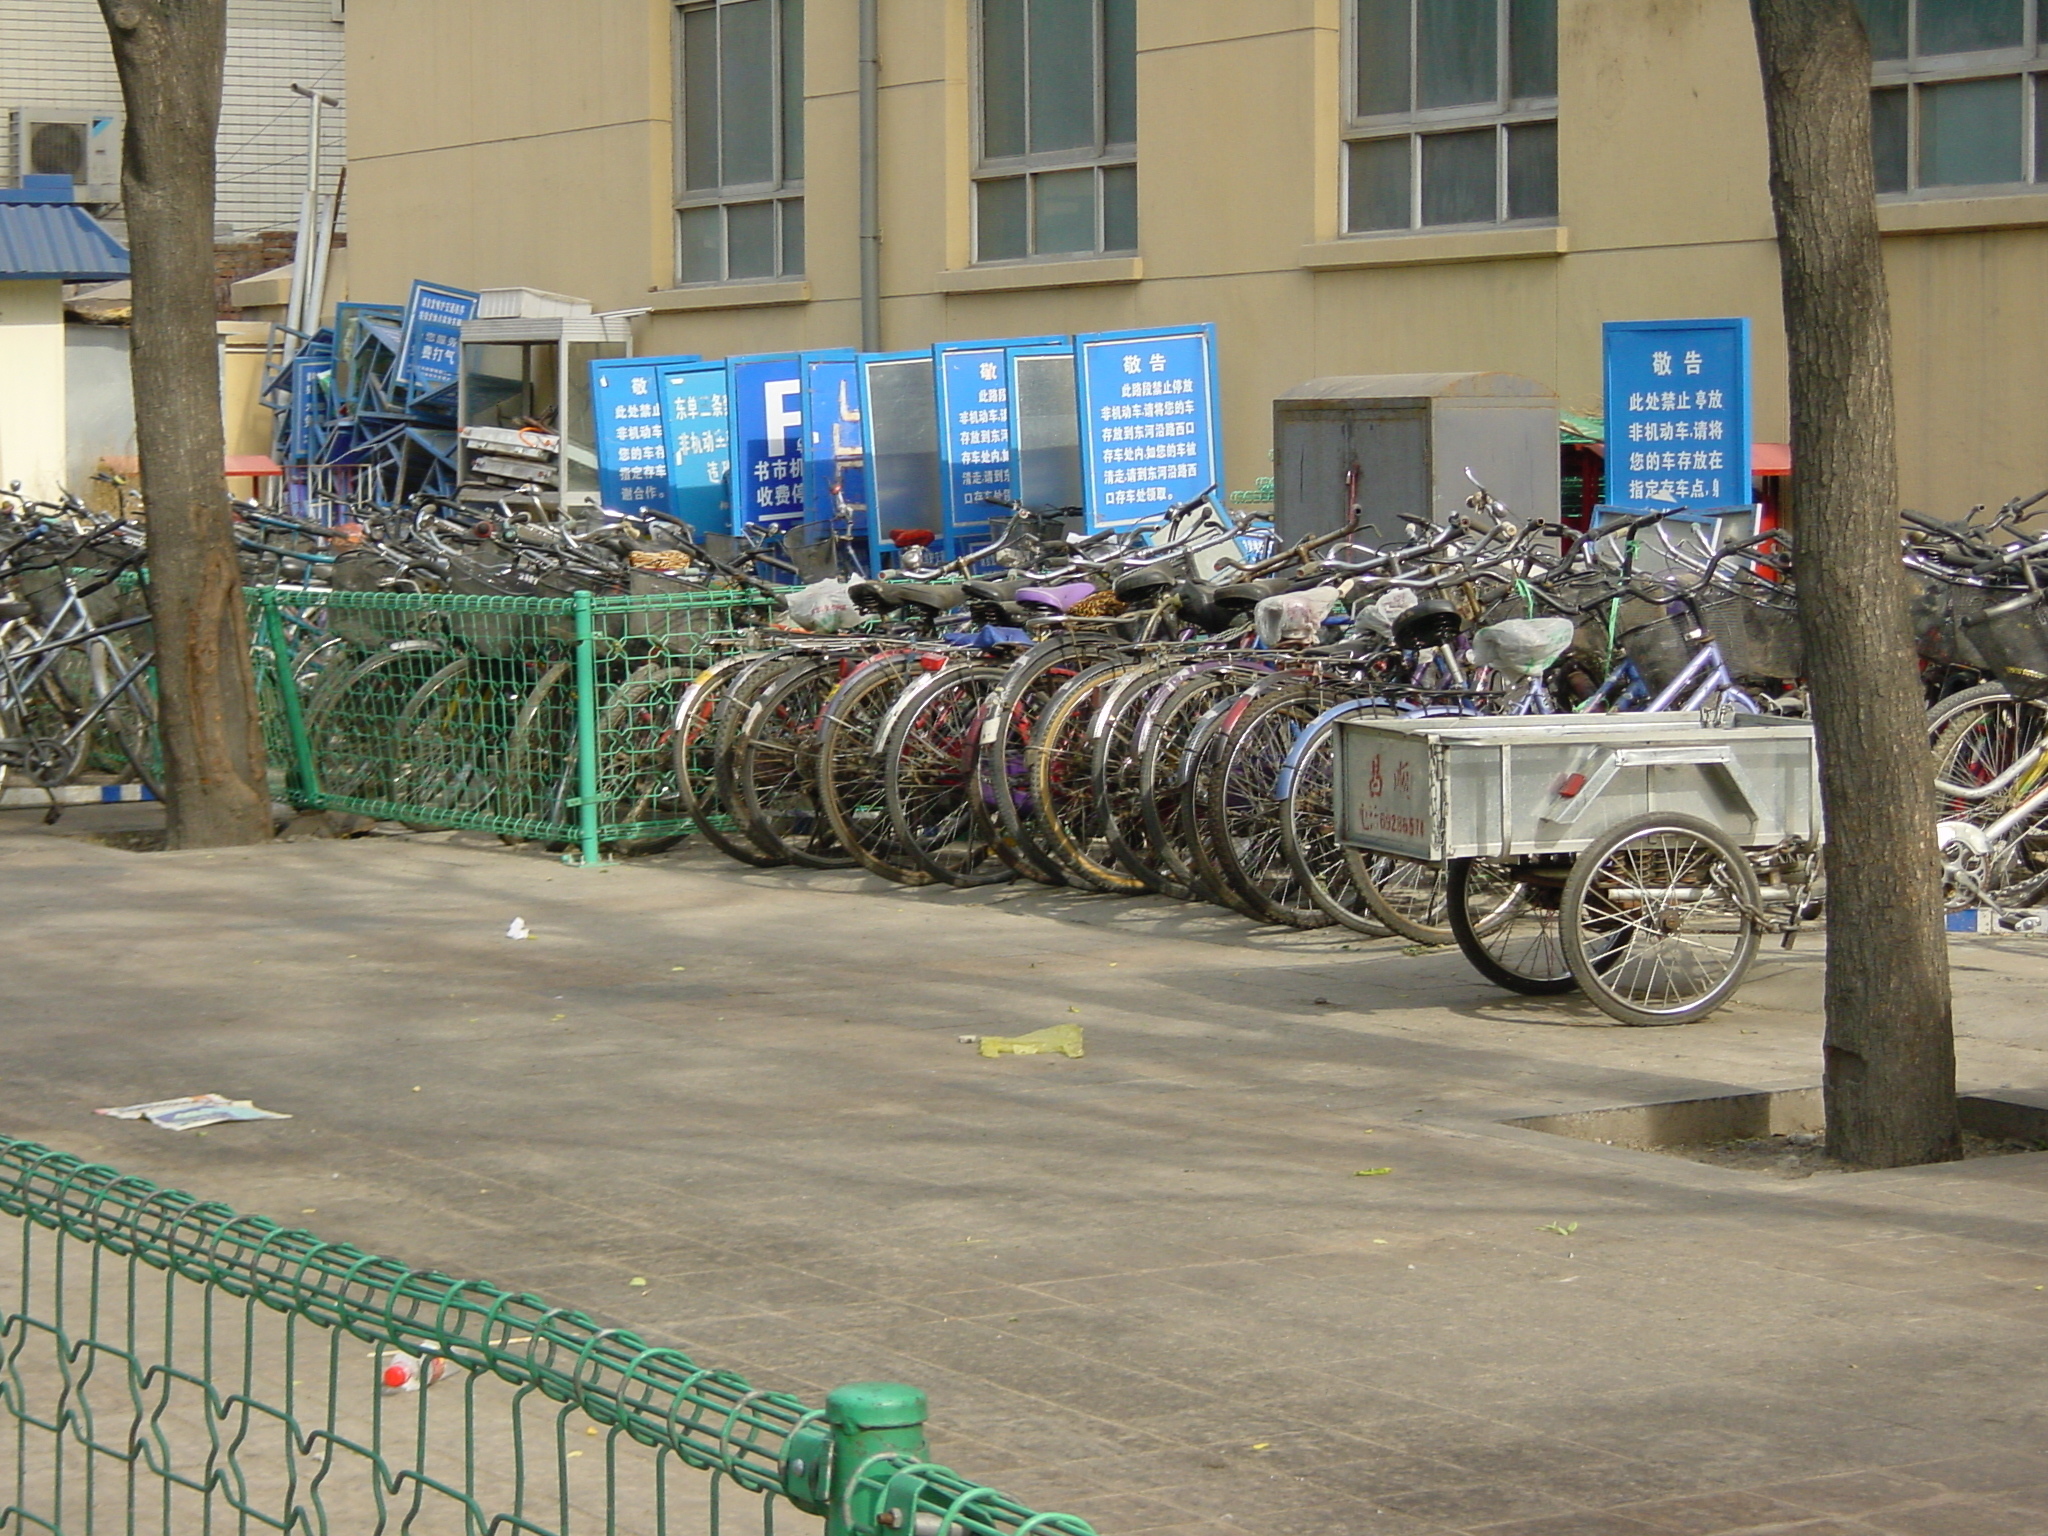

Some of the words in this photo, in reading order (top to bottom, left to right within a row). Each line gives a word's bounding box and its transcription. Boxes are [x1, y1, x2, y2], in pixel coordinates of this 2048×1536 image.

[979, 362, 997, 381] 敬
[1122, 353, 1166, 375] 敬告
[1652, 350, 1702, 376] 敬告
[631, 377, 648, 395] 敬
[1121, 378, 1193, 398] 此路段禁止停放
[615, 402, 661, 419] 此处禁止
[616, 425, 663, 441] 非机动车
[1102, 421, 1195, 442] 存放到东河沿路西口
[1629, 450, 1723, 472] 您的车存放在
